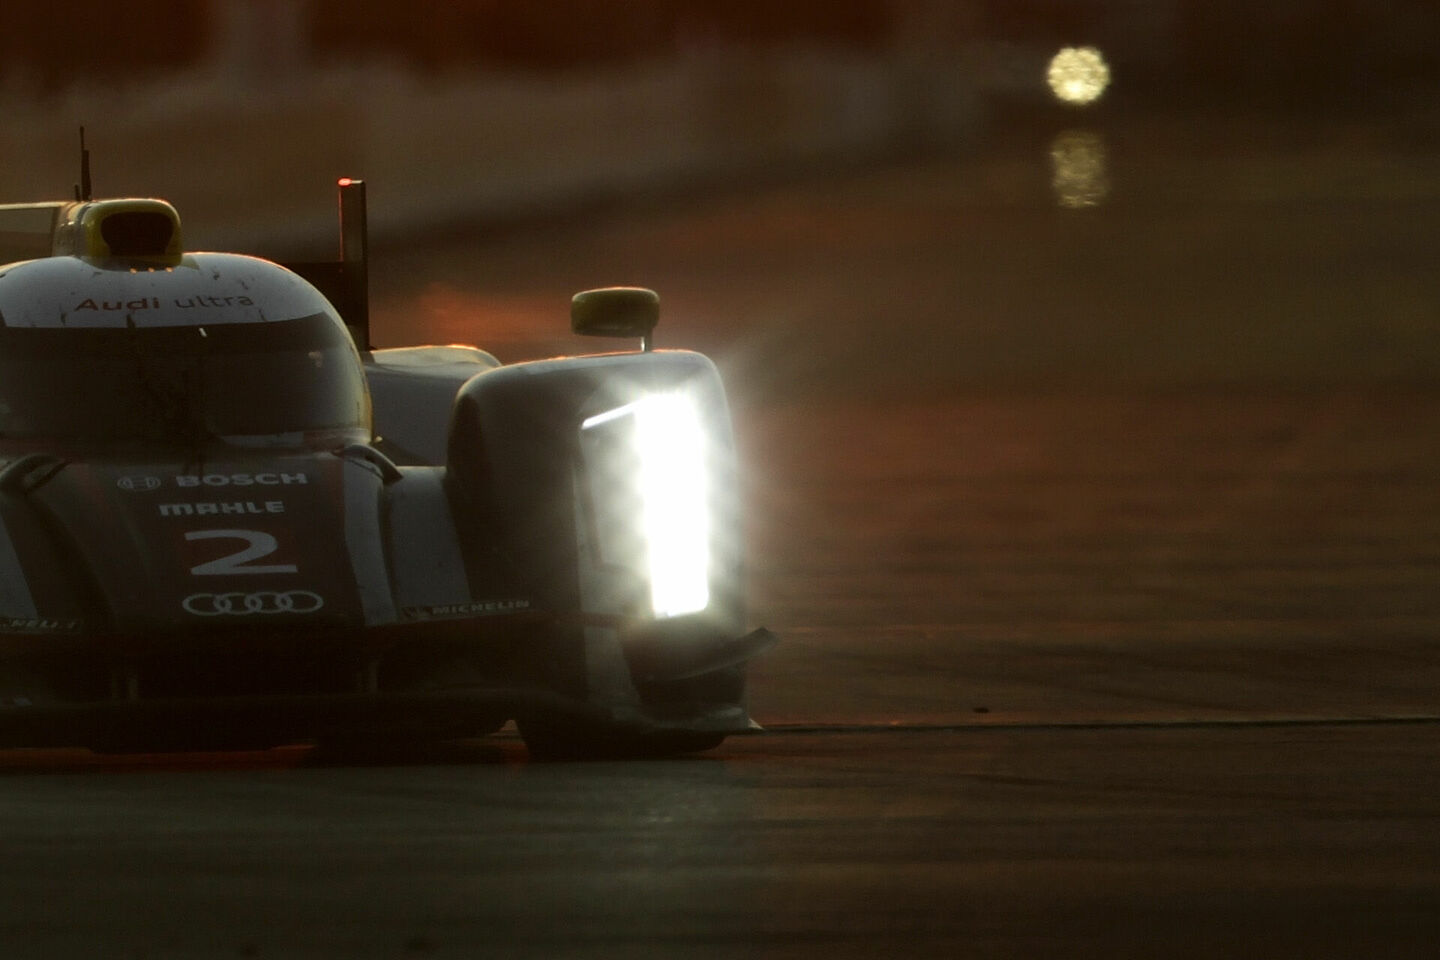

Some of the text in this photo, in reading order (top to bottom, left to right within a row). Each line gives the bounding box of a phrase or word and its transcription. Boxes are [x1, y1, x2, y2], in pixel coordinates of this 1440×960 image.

[74, 295, 254, 312] Audi ultra
[175, 473, 309, 488] BOSCH
[158, 500, 286, 517] MAHLE
[184, 529, 298, 576] 2
[431, 599, 531, 616] MICHELIN
